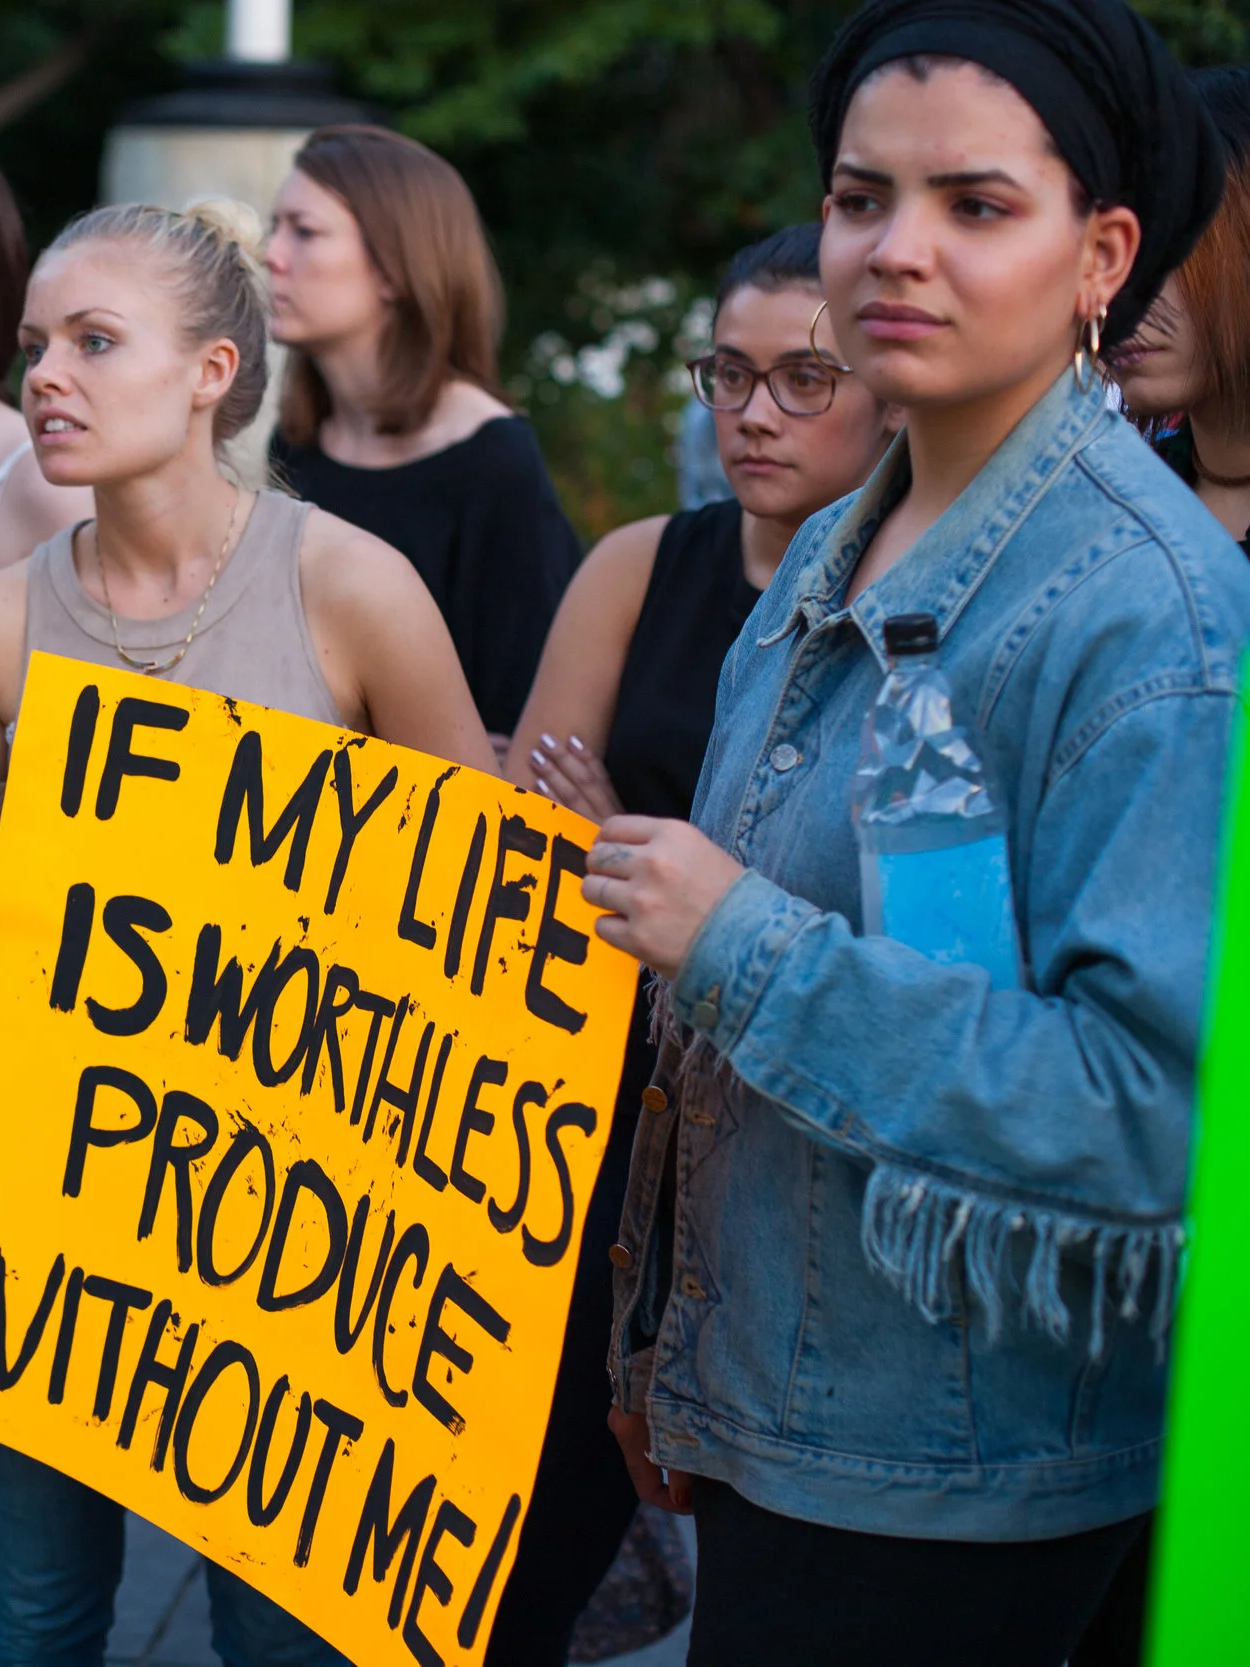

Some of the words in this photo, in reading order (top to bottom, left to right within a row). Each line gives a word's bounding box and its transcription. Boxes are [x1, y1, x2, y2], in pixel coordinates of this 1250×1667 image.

[61, 684, 190, 821] IF
[214, 730, 398, 915] MY
[397, 784, 590, 1036] LIFE
[49, 882, 172, 1037] IS
[185, 924, 597, 1268] WORTHLESS
[62, 1065, 511, 1435] PRODUCE
